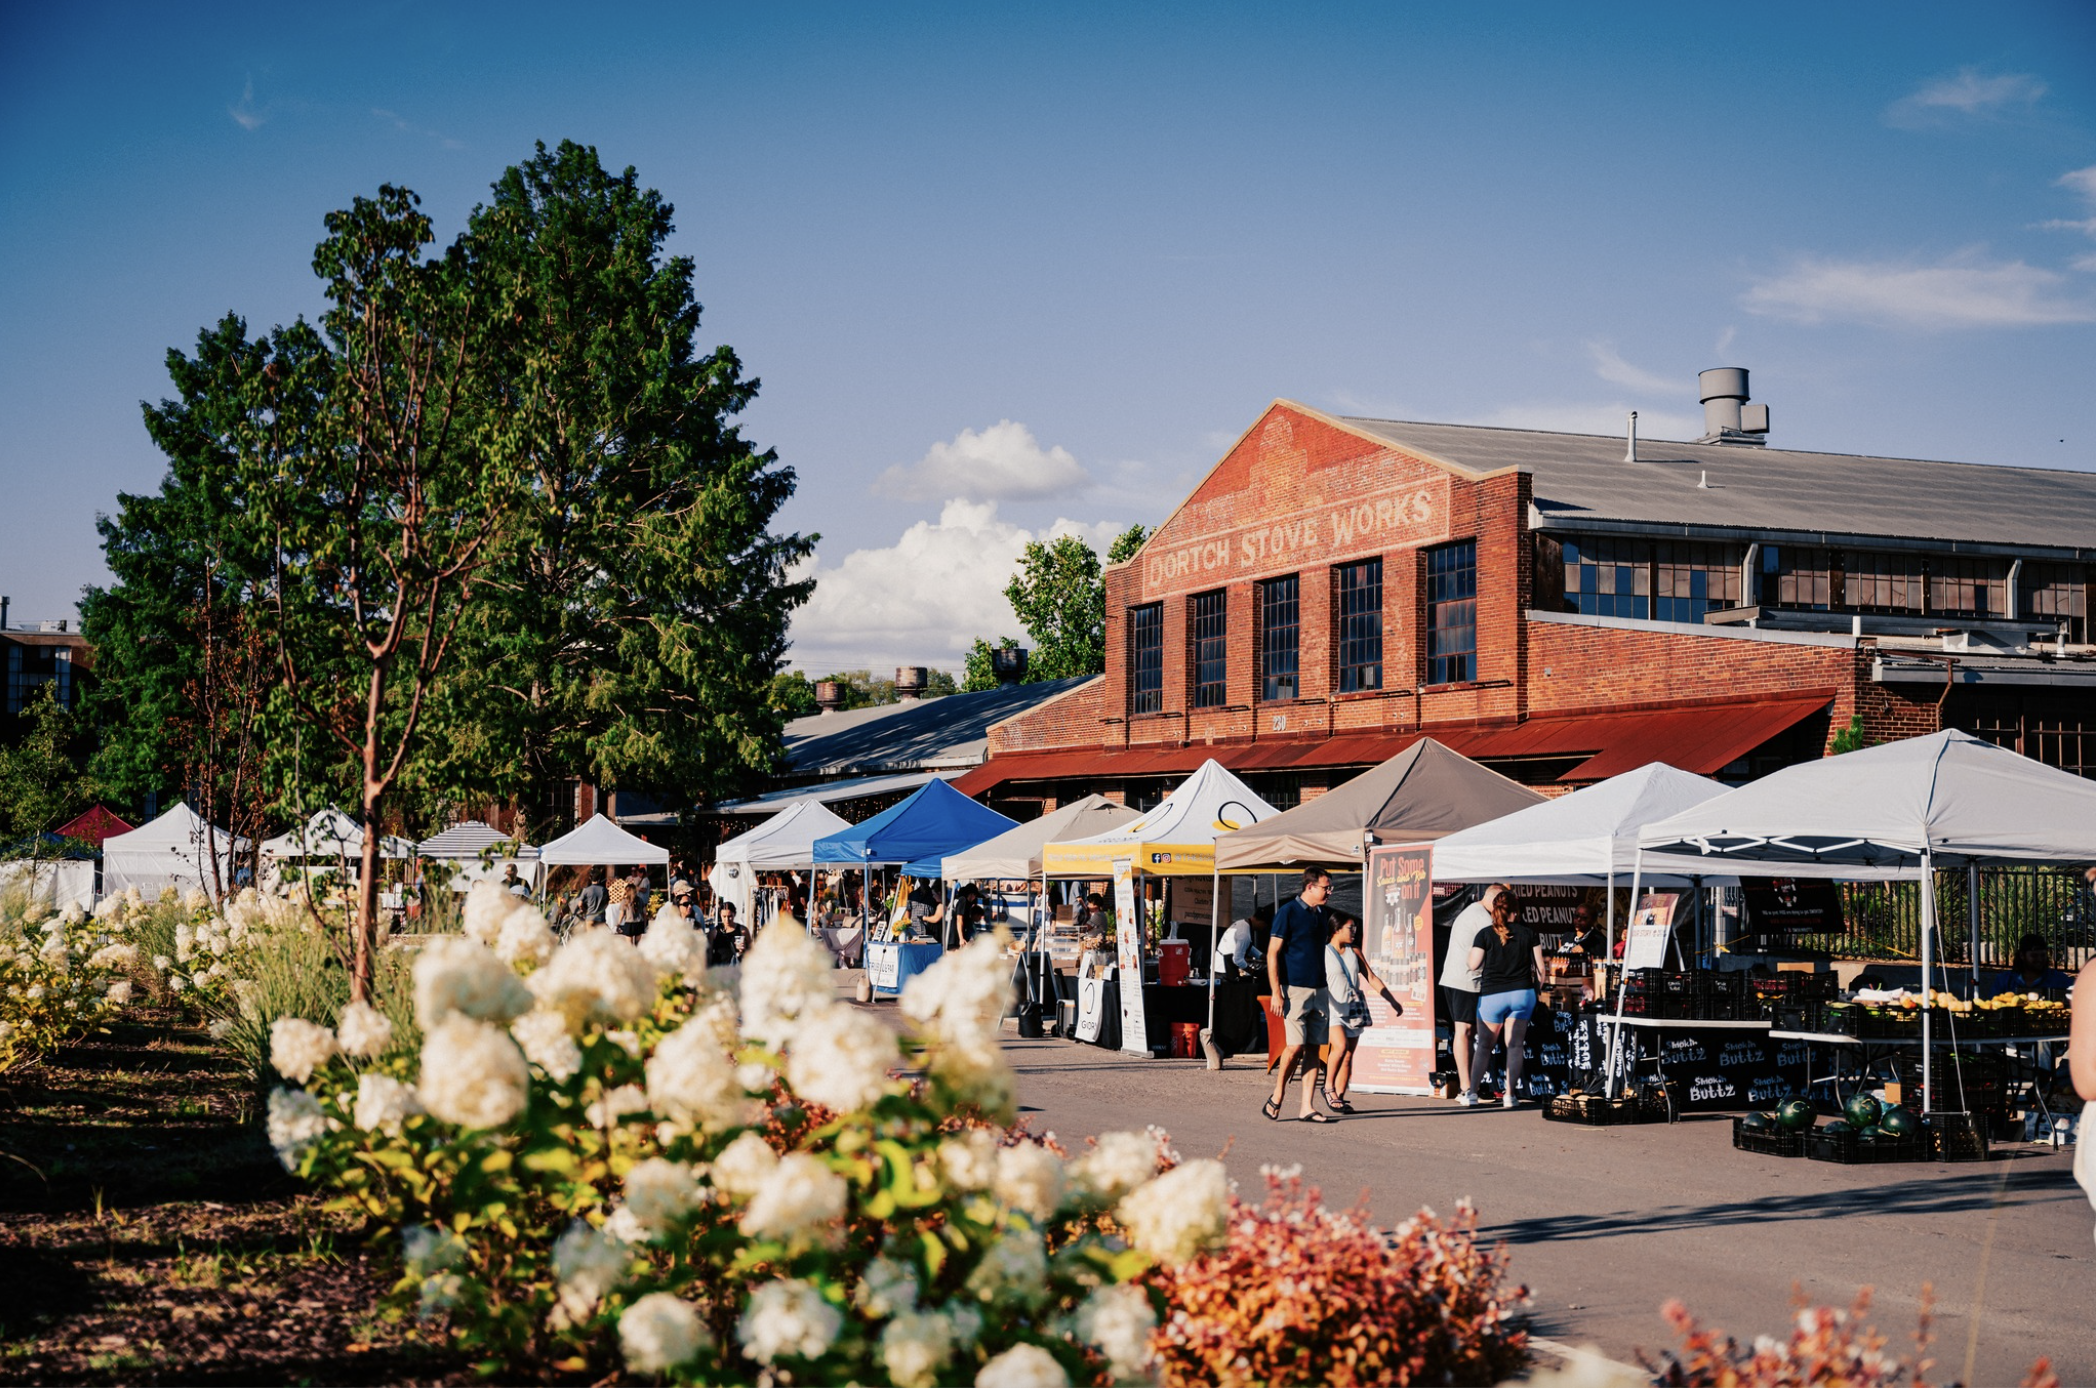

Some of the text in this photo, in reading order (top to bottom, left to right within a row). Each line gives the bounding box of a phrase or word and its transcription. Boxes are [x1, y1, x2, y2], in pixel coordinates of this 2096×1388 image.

[1149, 489, 1433, 588] DORTCH STOVE WORKS
[1273, 715, 1287, 731] 230
[1380, 856, 1424, 878] Put Some
[1401, 882, 1421, 900] on it
[1535, 885, 1578, 898] PEANUTS
[1725, 1040, 1757, 1051] Smokin
[1719, 1049, 1765, 1067] Buttz
[1694, 1074, 1727, 1086] Smokin
[1753, 1074, 1785, 1086] Smokin
[1690, 1084, 1736, 1102] Buttz
[1748, 1083, 1793, 1102] Buttz
